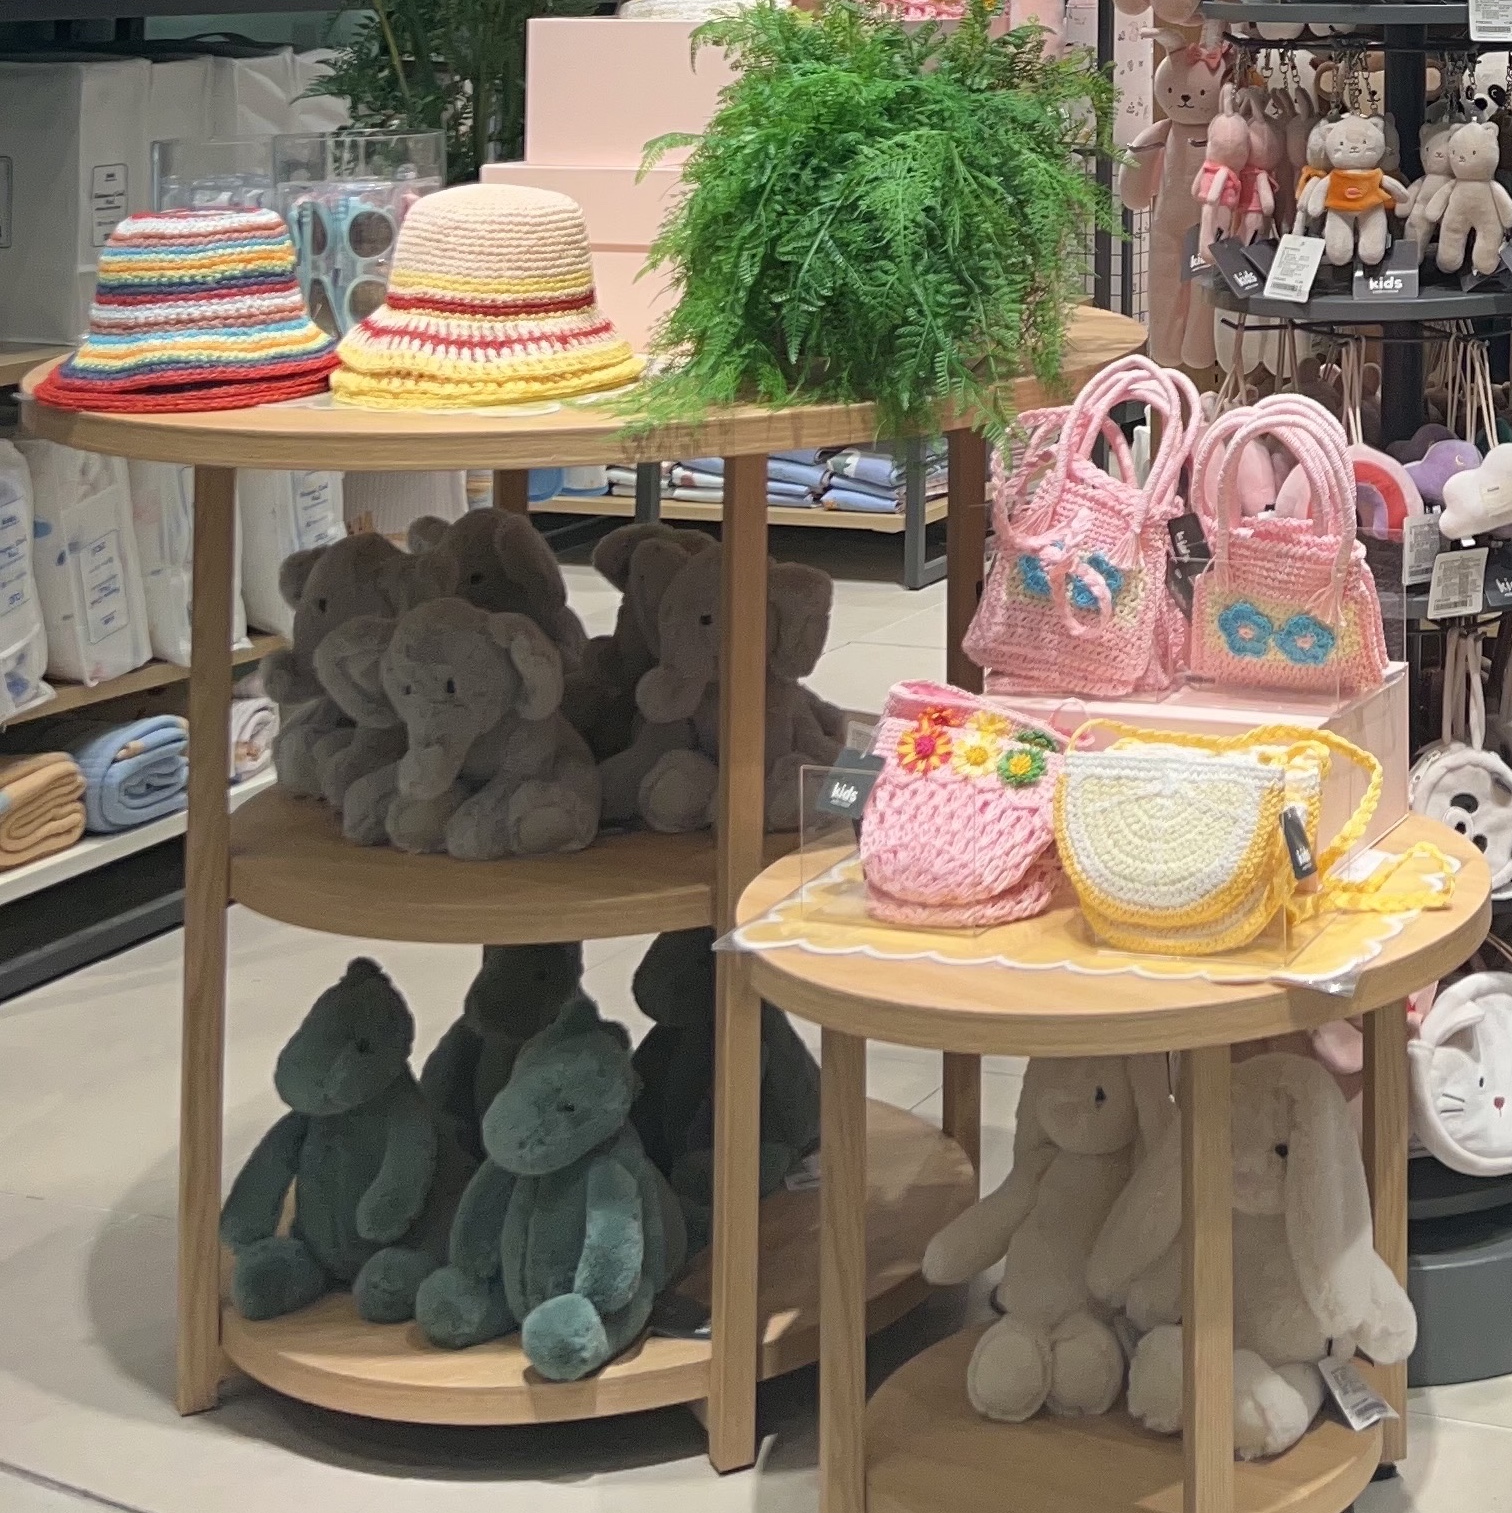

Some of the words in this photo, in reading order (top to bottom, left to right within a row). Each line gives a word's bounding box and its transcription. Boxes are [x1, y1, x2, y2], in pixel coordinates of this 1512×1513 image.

[1233, 270, 1258, 287] kids
[1368, 275, 1404, 289] kids
[830, 781, 859, 803] kids
